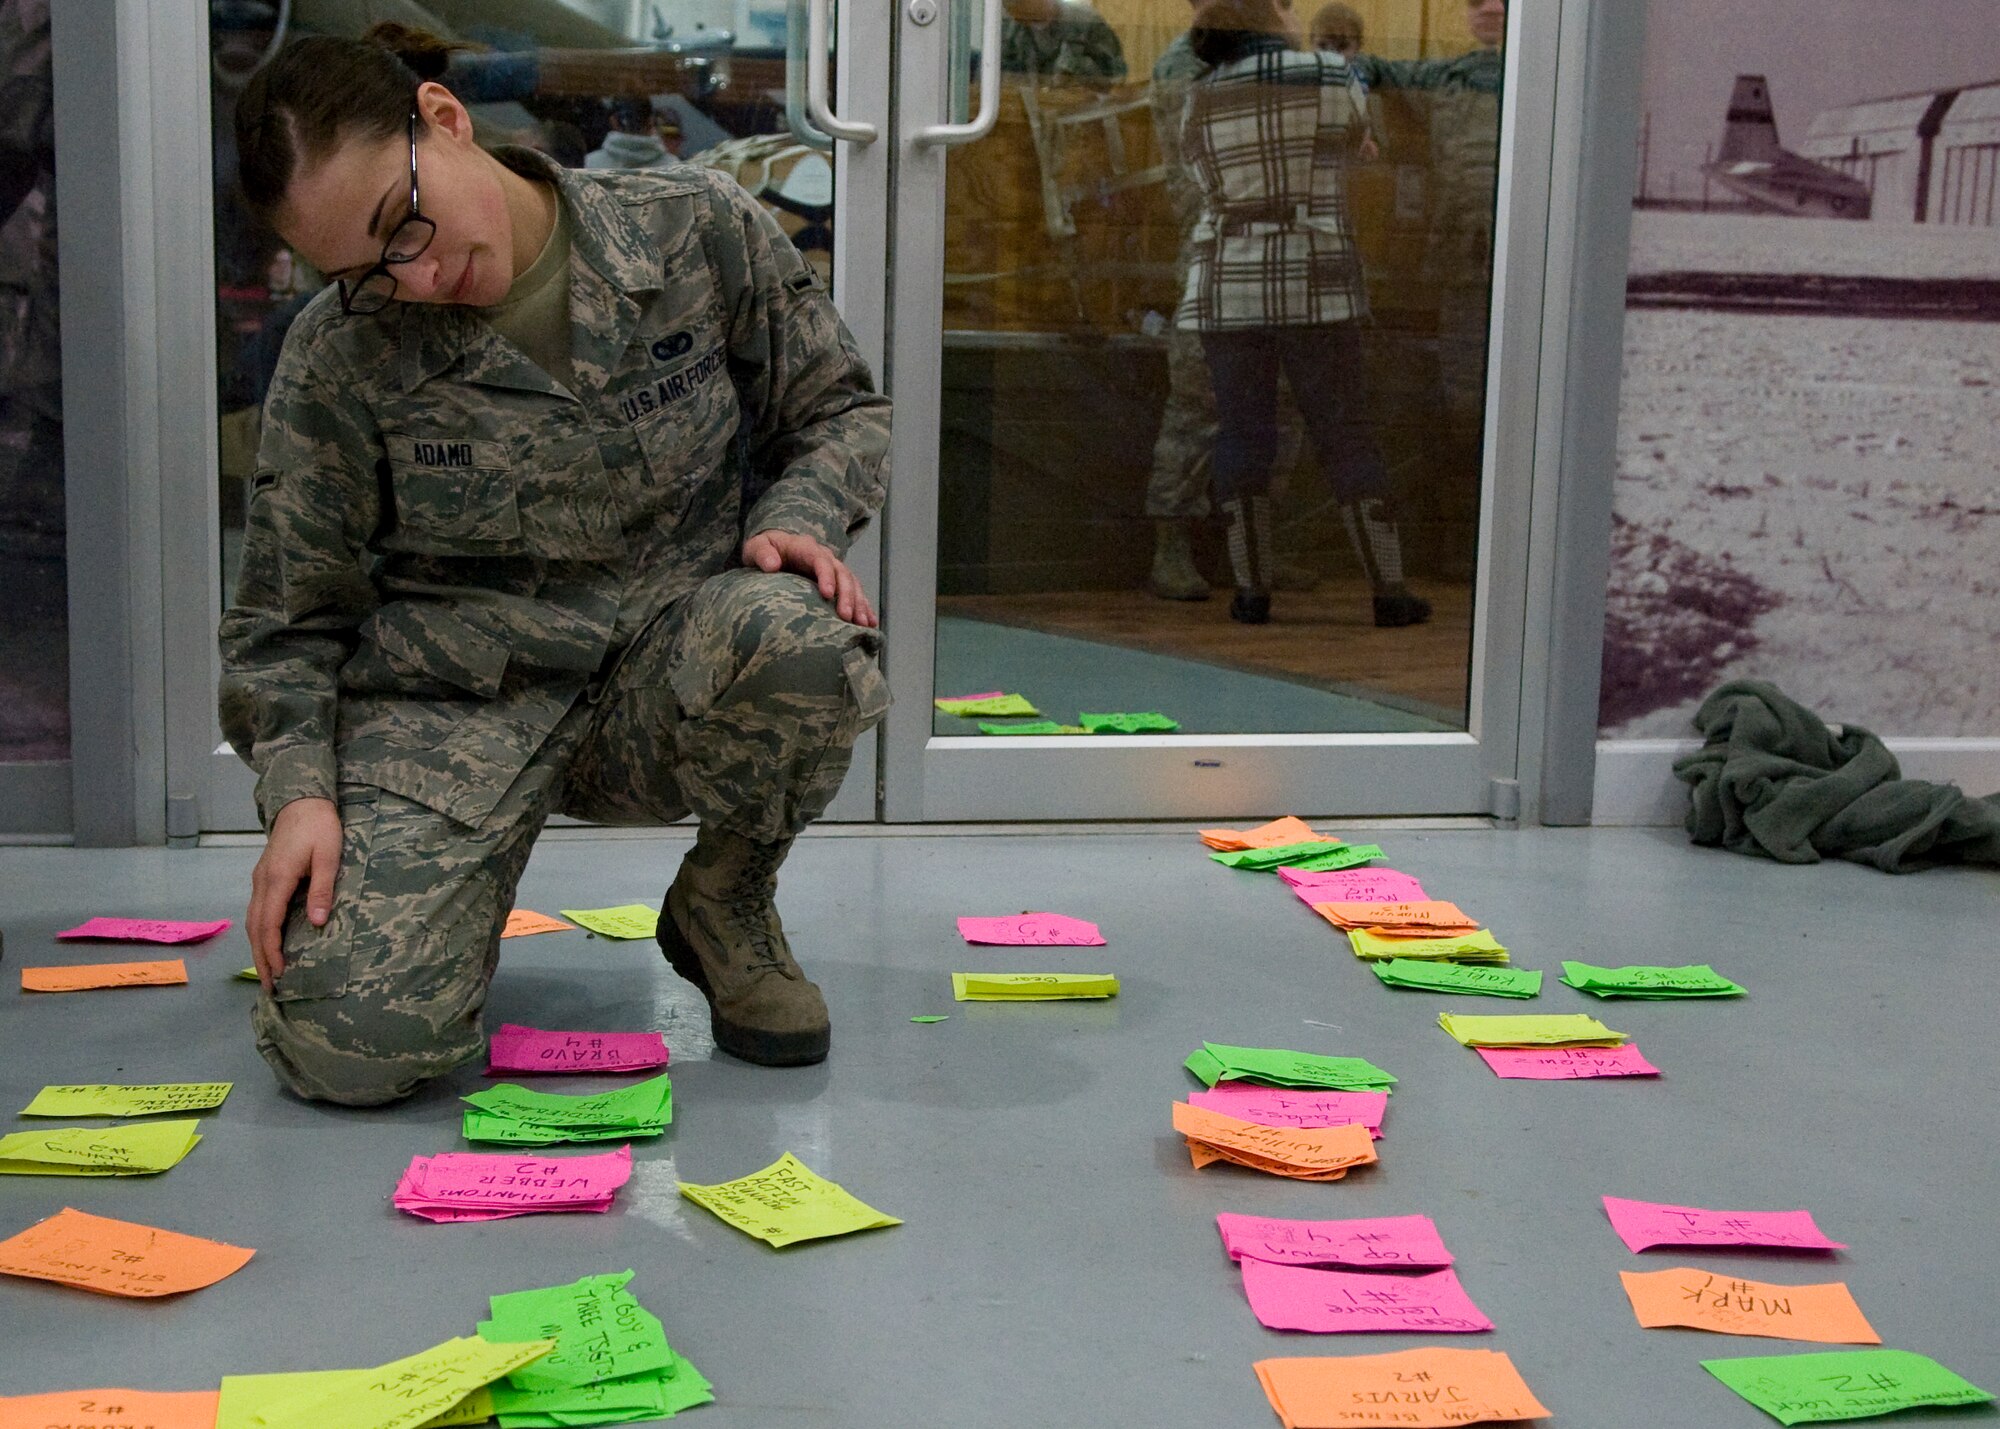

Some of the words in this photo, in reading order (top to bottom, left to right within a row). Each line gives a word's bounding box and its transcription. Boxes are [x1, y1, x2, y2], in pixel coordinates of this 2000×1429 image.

[622, 390, 658, 422] U.S.
[657, 373, 687, 407] AIR
[414, 443, 472, 467] ADAMO
[565, 1036, 602, 1047] #4
[540, 1049, 619, 1060] BRAVO
[514, 1162, 558, 1175] #2
[477, 1175, 589, 1189] WEBBER
[769, 1168, 812, 1192] FAST
[111, 1249, 145, 1265] #2
[1704, 1275, 1754, 1293] #1
[1342, 1289, 1408, 1305] #1
[1680, 1286, 1792, 1316] MARK
[1391, 1371, 1432, 1383] #2
[1818, 1373, 1901, 1392] #2
[1350, 1386, 1468, 1404] JARVIS
[79, 1400, 124, 1415] #2
[1769, 1400, 1833, 1411] LOCK
[1338, 1411, 1418, 1423] BERNS
[1442, 1408, 1525, 1422] TEAM
